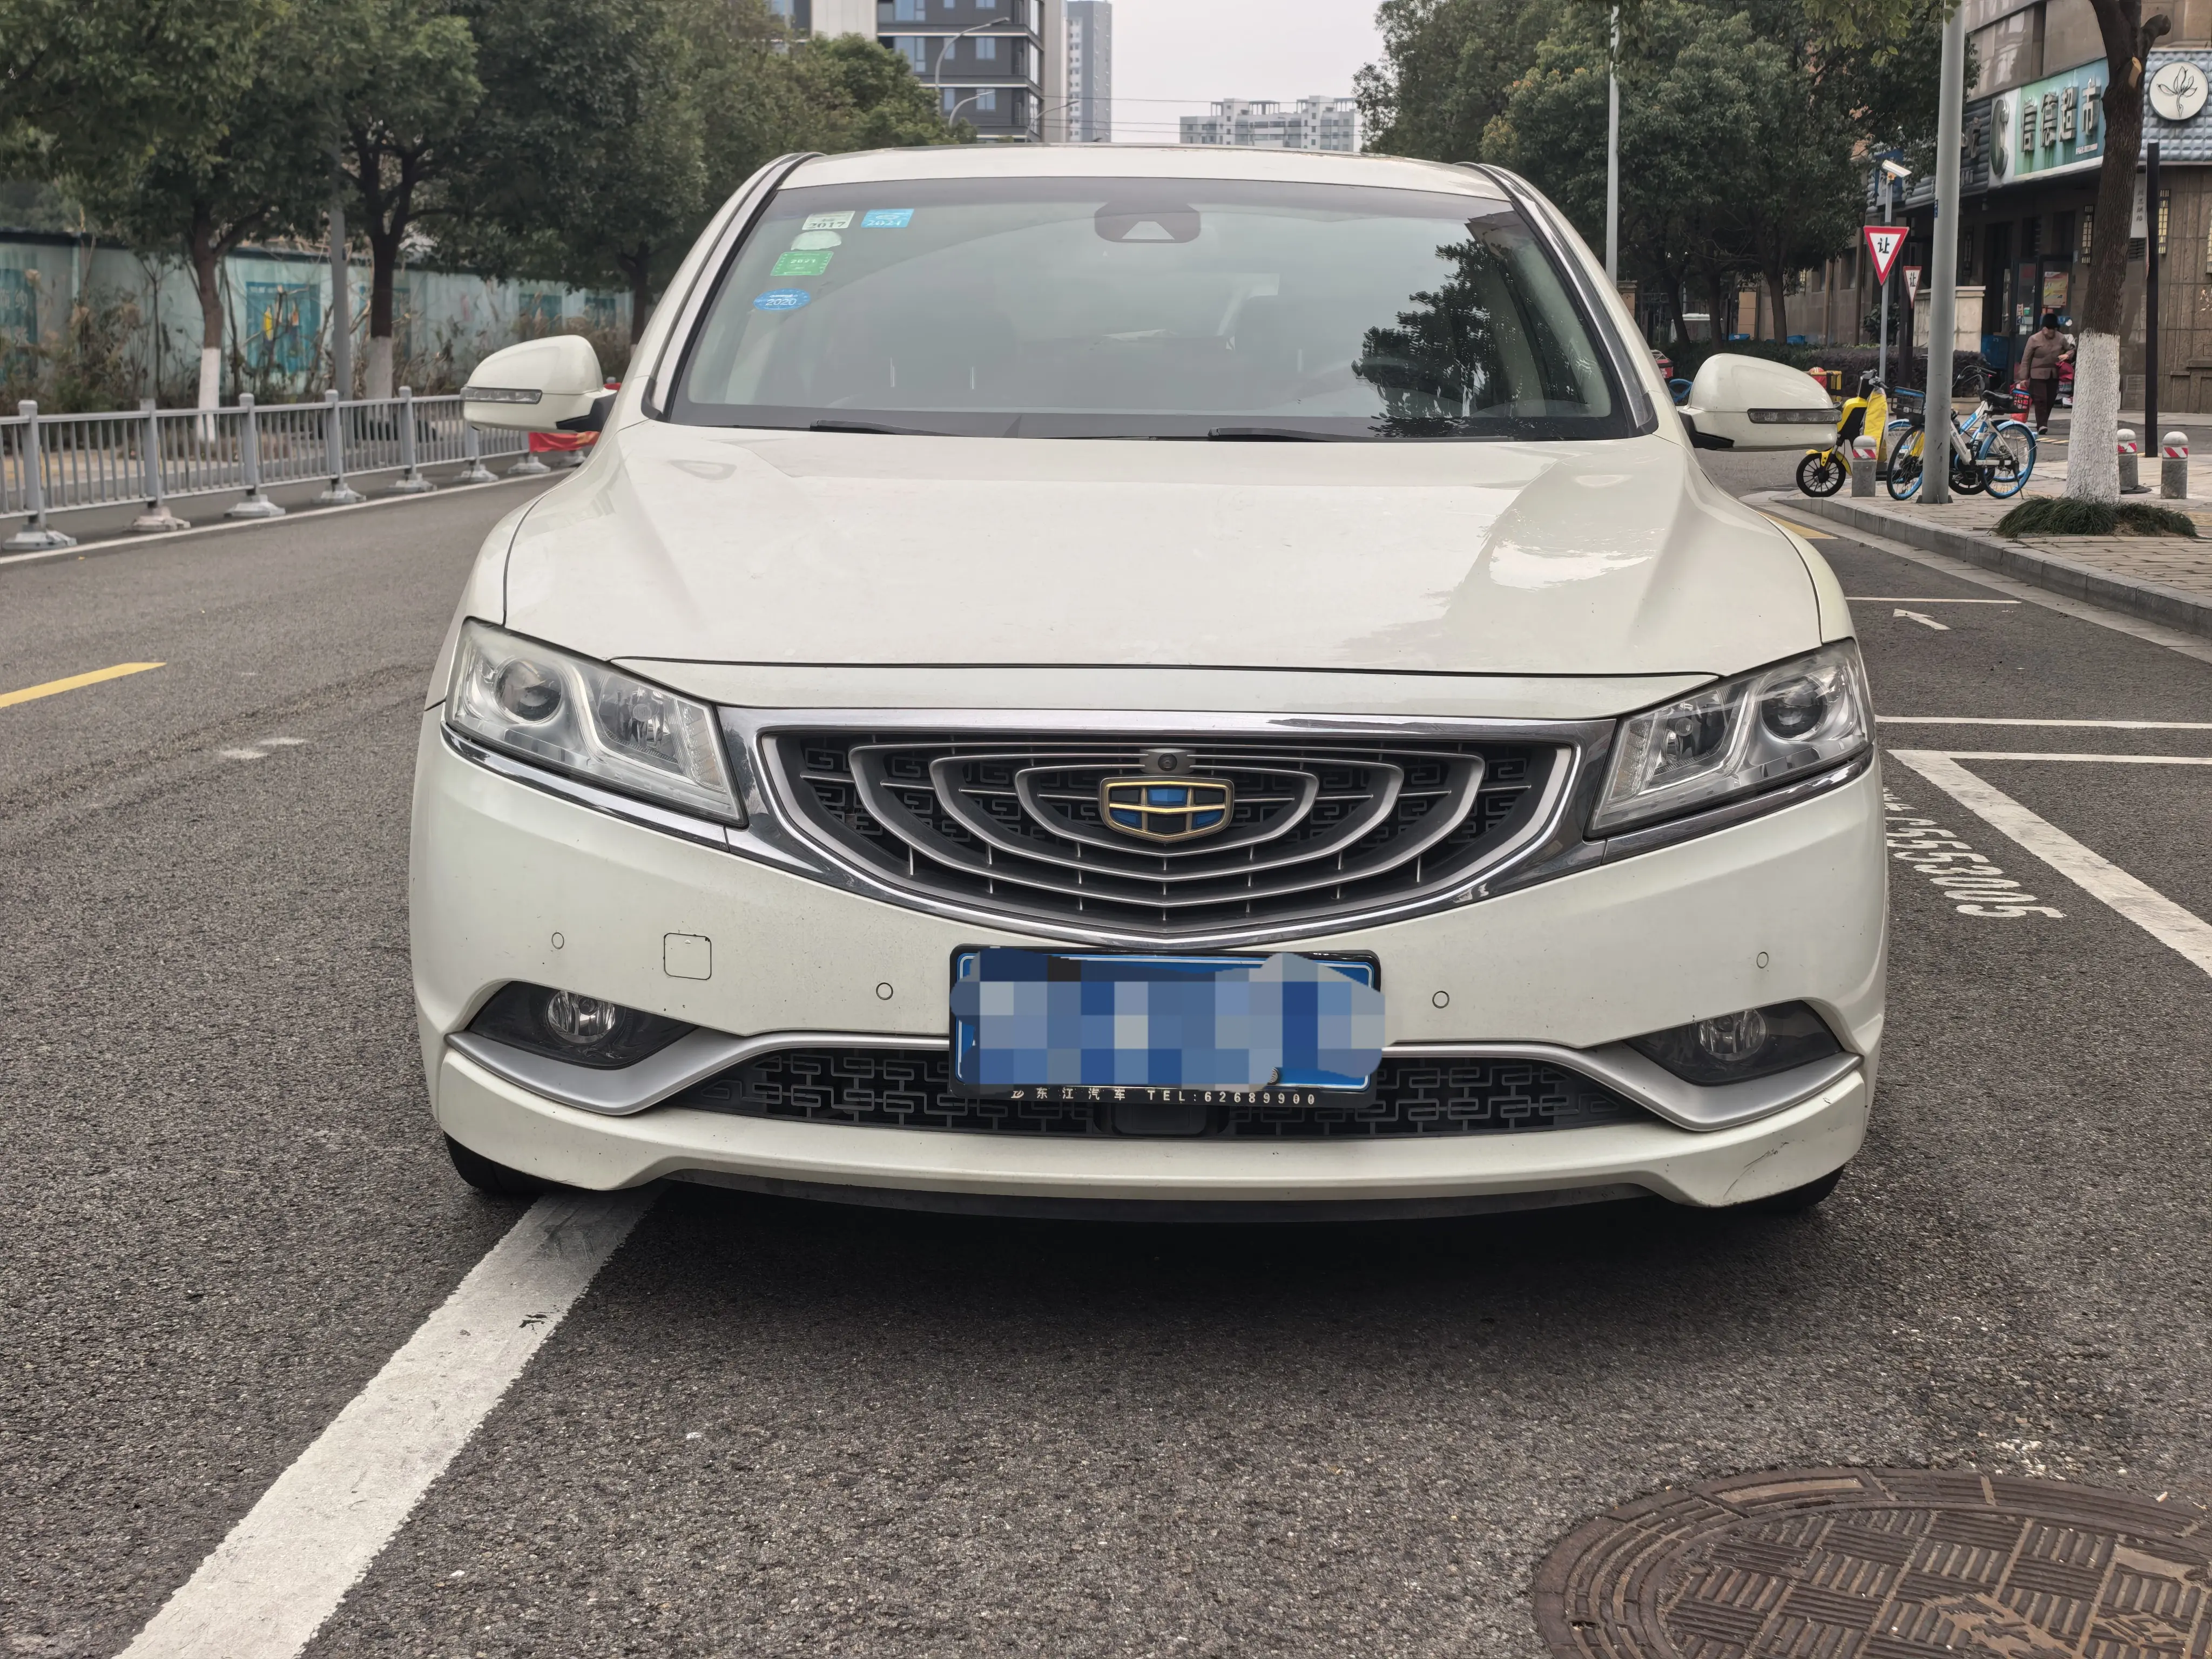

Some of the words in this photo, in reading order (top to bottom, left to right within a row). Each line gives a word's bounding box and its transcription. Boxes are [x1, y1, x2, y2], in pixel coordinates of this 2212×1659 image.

[2020, 77, 2102, 152] 信德超市
[1877, 237, 1890, 254] 让
[1910, 272, 1917, 287] 让
[765, 298, 797, 306] 2020
[1036, 1087, 1125, 1101] 东江汽车
